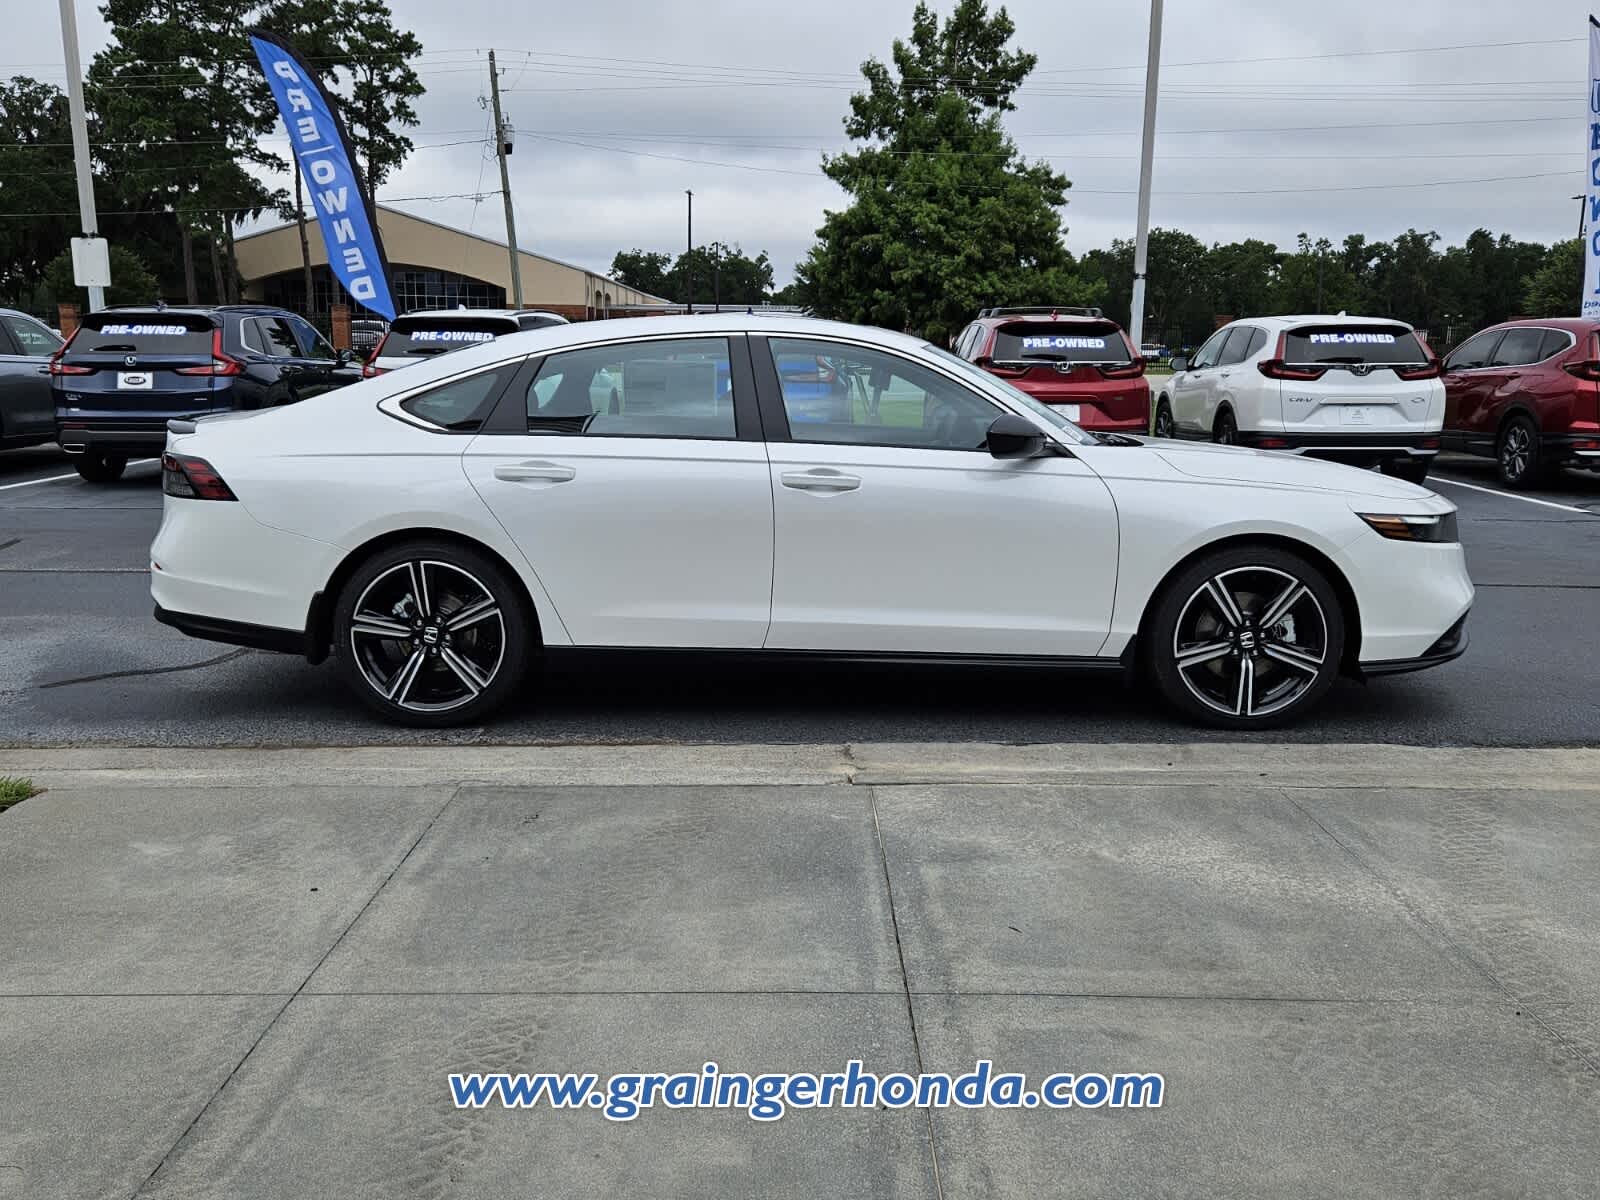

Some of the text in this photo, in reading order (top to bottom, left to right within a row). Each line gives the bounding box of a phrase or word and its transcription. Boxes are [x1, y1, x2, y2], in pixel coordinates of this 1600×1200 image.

[100, 325, 187, 336] PRE-OWNED
[411, 331, 494, 342] PRE-OWNED
[1310, 335, 1395, 345] PRE-OWNED
[1022, 338, 1105, 349] PRE-OWNED
